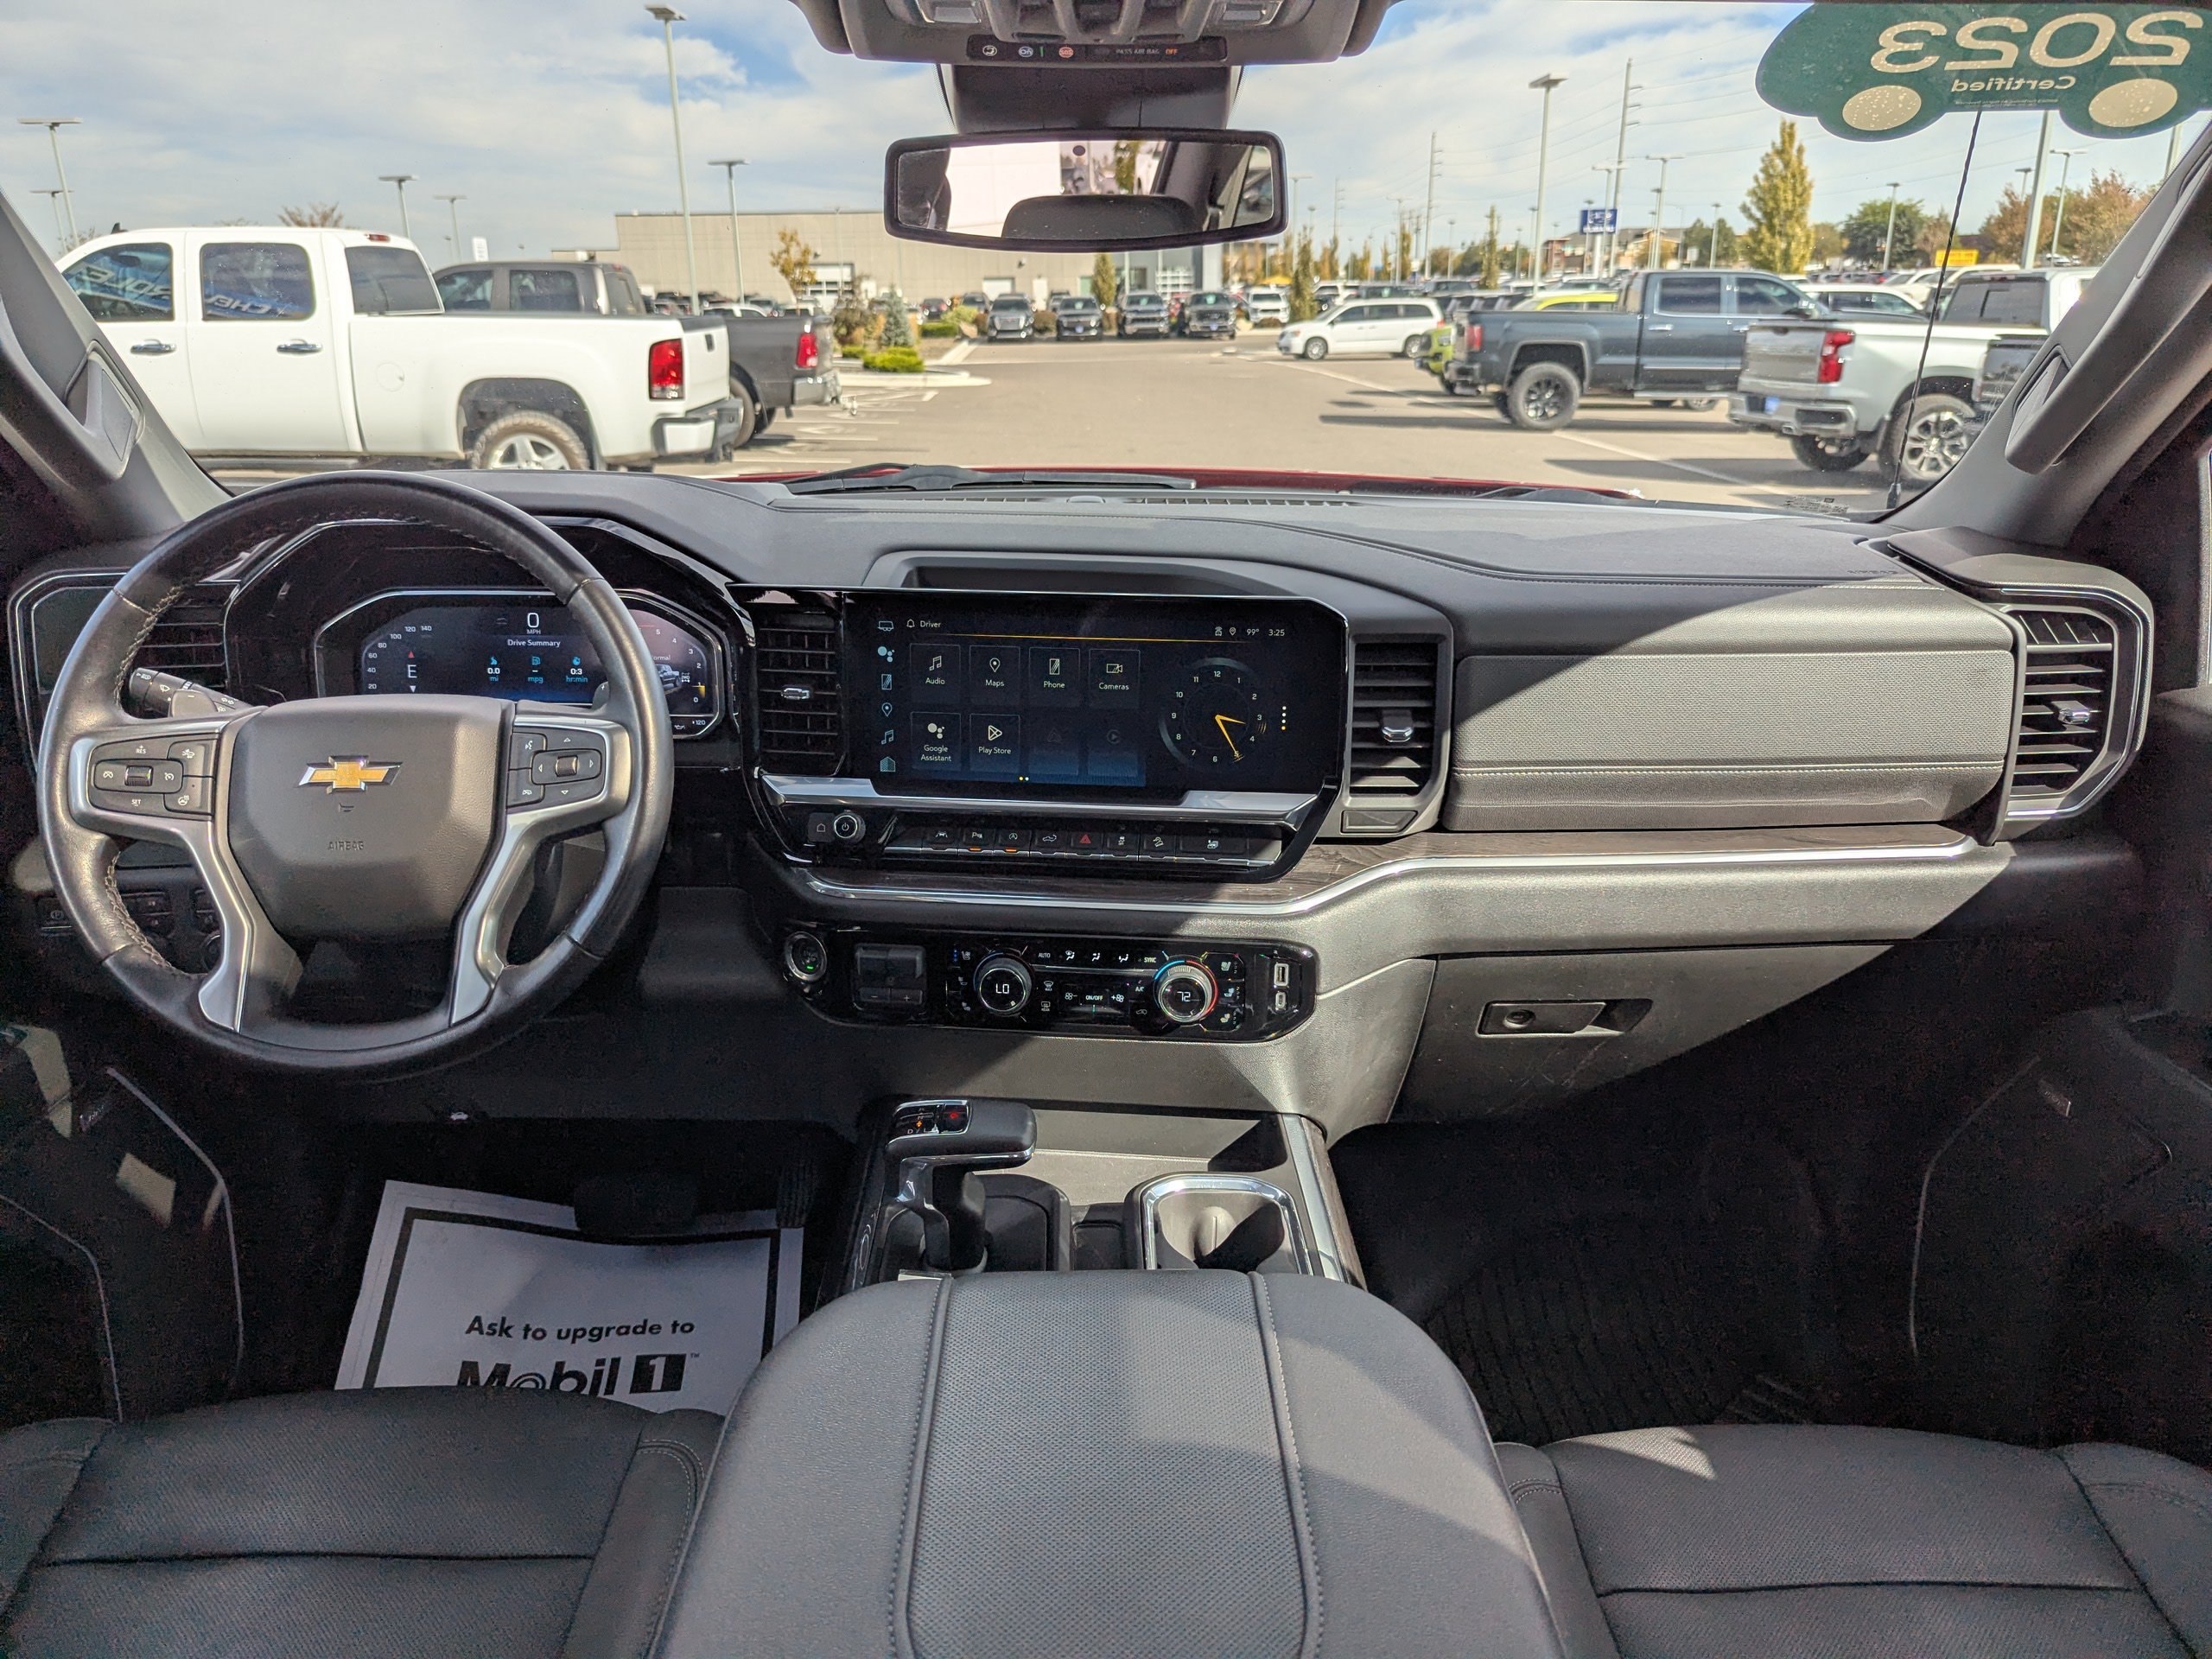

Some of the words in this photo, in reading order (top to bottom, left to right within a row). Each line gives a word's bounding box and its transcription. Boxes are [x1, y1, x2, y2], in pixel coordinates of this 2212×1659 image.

[527, 612, 539, 628] 0
[407, 664, 417, 678] E
[978, 747, 992, 755] Play
[327, 841, 364, 850] AIRBAG
[1177, 991, 1191, 1002] 72
[465, 1315, 515, 1338] Ask
[522, 1324, 547, 1340] to
[556, 1319, 662, 1344] upgrade
[671, 1319, 695, 1334] to
